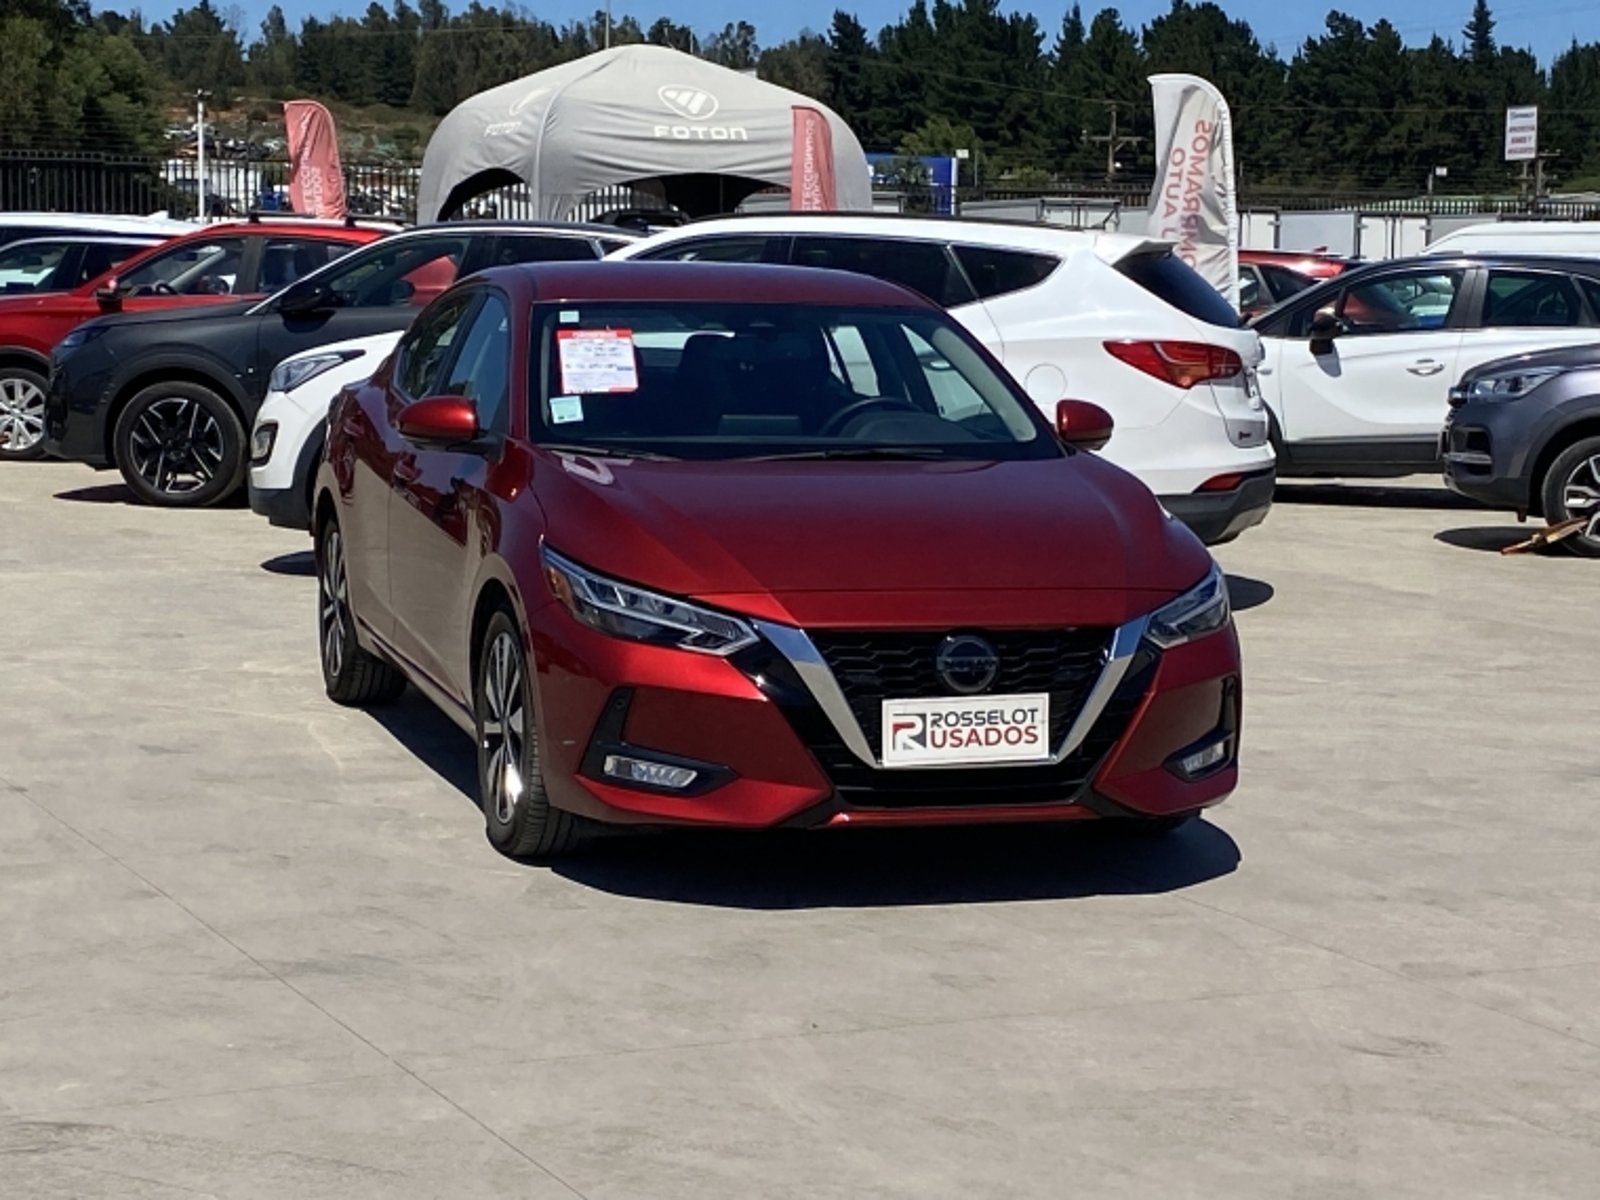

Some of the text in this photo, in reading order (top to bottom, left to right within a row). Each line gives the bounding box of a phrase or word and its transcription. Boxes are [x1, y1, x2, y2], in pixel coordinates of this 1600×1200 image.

[653, 125, 748, 140] FOTON
[930, 708, 1039, 729] ROSSELOT
[930, 726, 1039, 749] USADOS
